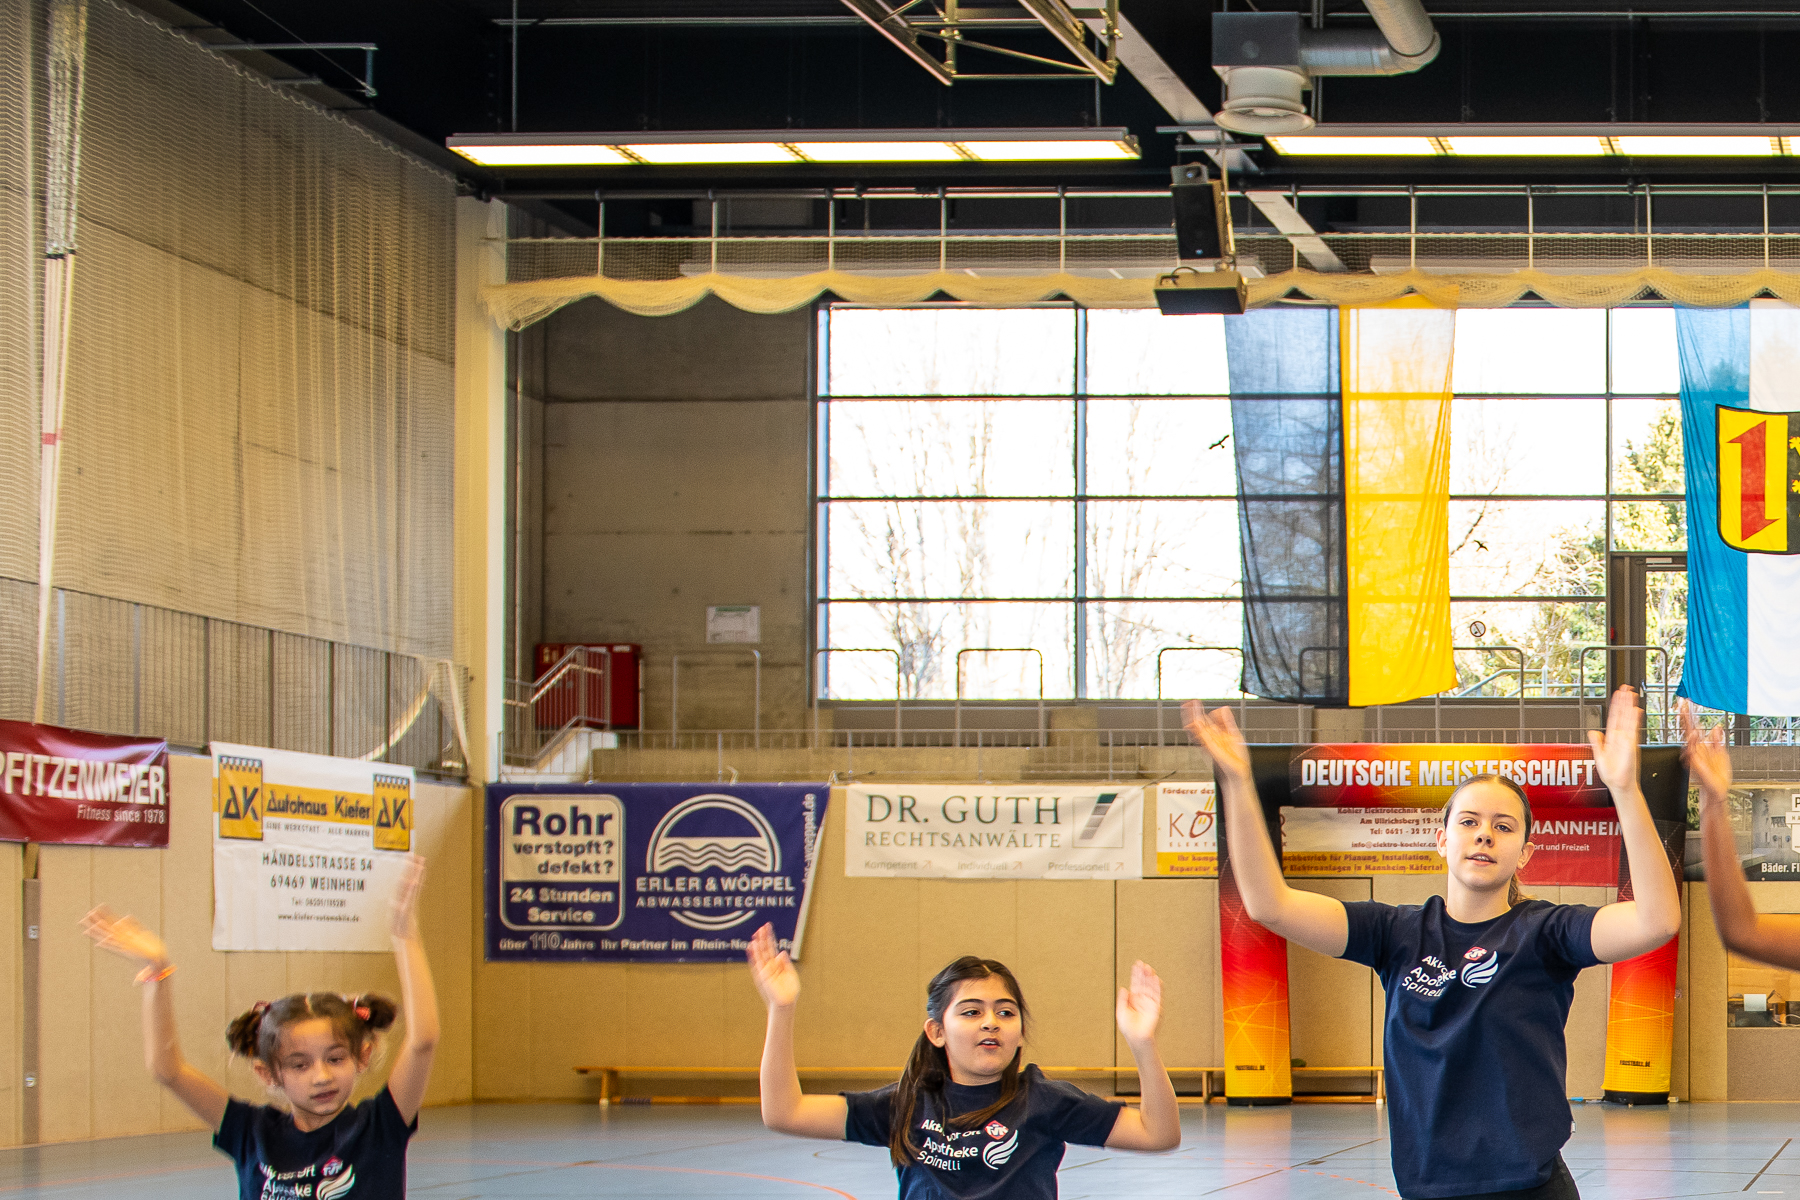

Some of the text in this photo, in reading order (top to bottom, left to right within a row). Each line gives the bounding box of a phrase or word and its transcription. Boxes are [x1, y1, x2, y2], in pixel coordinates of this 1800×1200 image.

[1302, 759, 1412, 787] DEUTSCHE
[77, 804, 166, 824] Fitness since 1978
[266, 790, 328, 816] Autohaus
[334, 794, 371, 820] Kiefer
[866, 794, 1062, 825] DR. GUTH
[512, 805, 613, 837] Rohr
[1375, 817, 1420, 826] Ullrichsberg
[865, 830, 1062, 848] RECHTSANWÄLTE
[1352, 841, 1437, 849] info@elektro-koehler.co
[512, 840, 614, 857] verstopft?
[1382, 853, 1432, 862] Installation,
[262, 849, 356, 871] HÄNDELSTRASSE
[538, 860, 614, 875] defekt?
[864, 860, 1110, 872] Kompetent Individuell Professionell
[1761, 862, 1789, 873] Bäder.
[270, 874, 365, 892] 69469 WEINHEIM
[635, 873, 796, 893] ERLER & WÖPPEL
[510, 887, 615, 904] 24 Stunden
[636, 895, 796, 909] ABWASSERTECHNIK
[527, 906, 596, 923] Service
[530, 932, 560, 950] 110
[560, 939, 596, 950] Jahre
[621, 938, 670, 950] Partner
[671, 939, 688, 950] im
[922, 1137, 979, 1158] Apotheke
[917, 1150, 961, 1171] Spinelli
